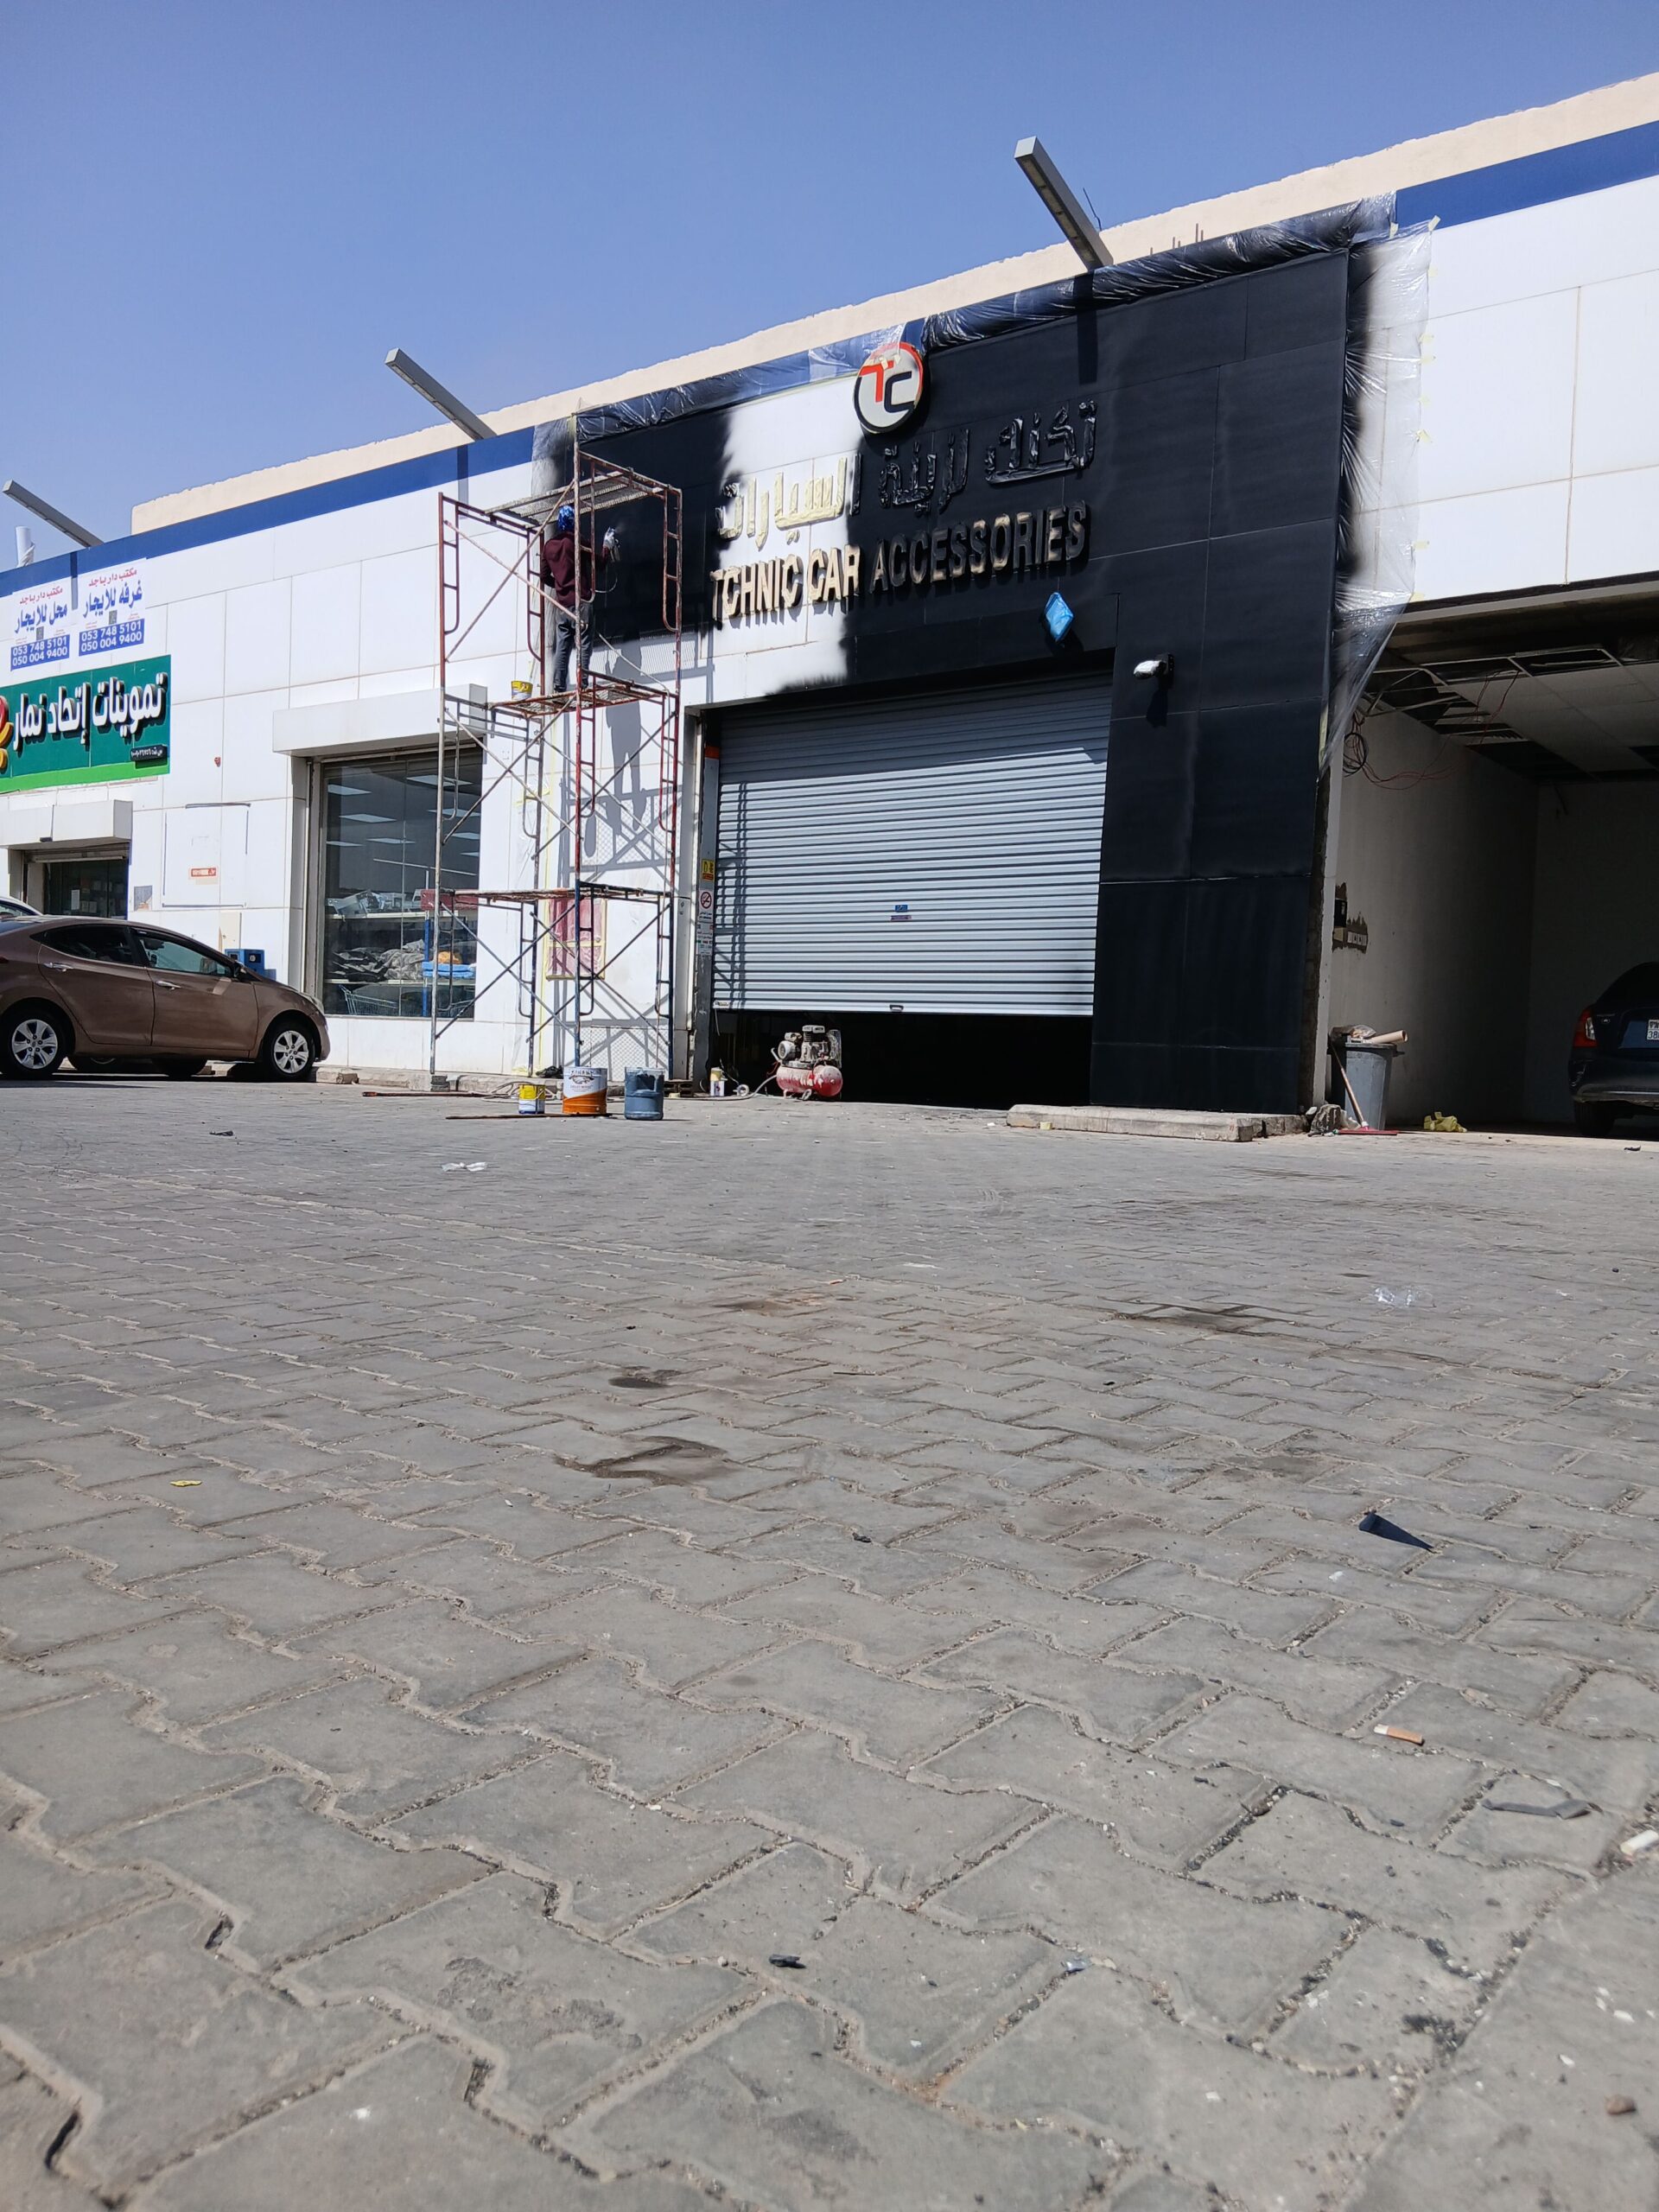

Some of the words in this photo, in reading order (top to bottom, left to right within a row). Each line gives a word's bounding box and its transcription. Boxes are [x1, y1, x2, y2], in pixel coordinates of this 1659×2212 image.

[715, 452, 862, 551] السيارات
[807, 544, 861, 605] CAR
[869, 501, 1087, 594] ACCESSORIES
[12, 645, 28, 657] 053
[29, 641, 45, 653] 748
[47, 636, 67, 649] 5101
[81, 630, 98, 642] 053
[100, 626, 118, 638] 748
[119, 620, 142, 634] 5101
[81, 640, 98, 652] 050
[99, 637, 117, 648] 004
[118, 632, 142, 645] 9400
[12, 656, 28, 666] 050
[29, 651, 45, 663] 004
[47, 646, 67, 658] 9400
[13, 693, 46, 751] نمار
[92, 672, 166, 738] تموينات
